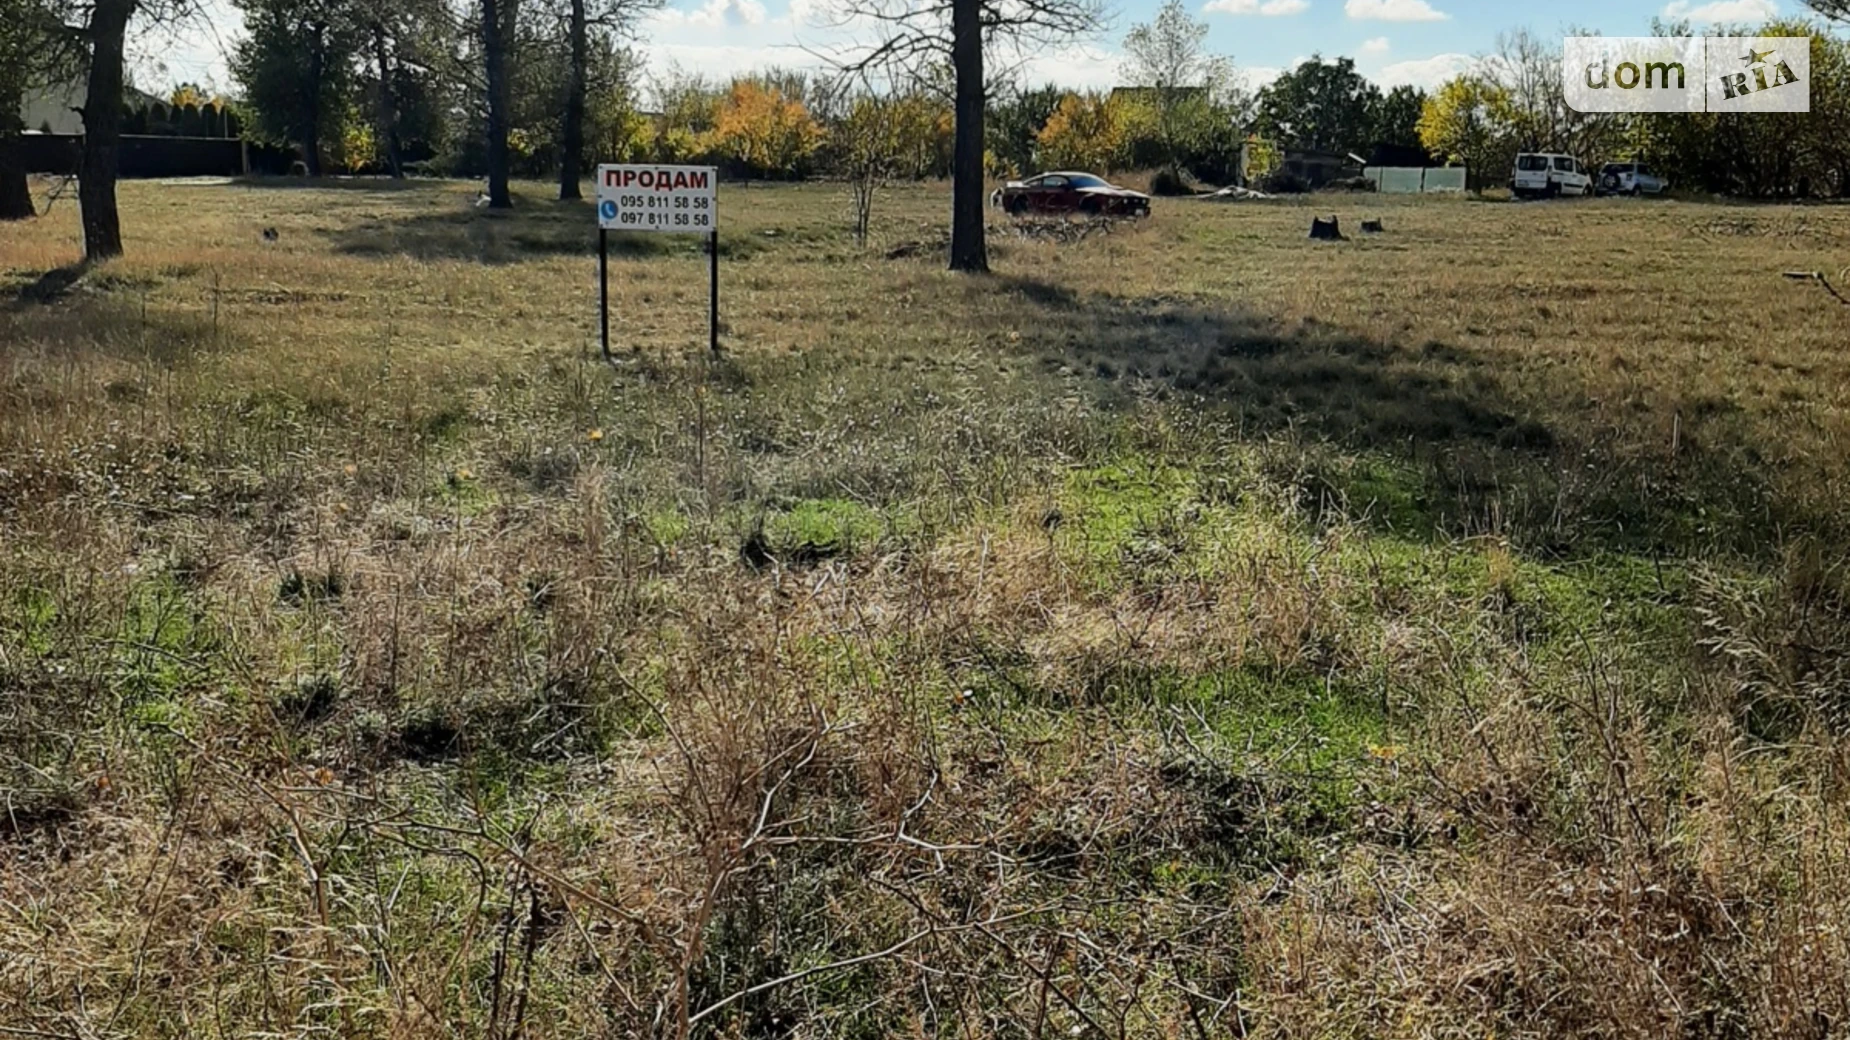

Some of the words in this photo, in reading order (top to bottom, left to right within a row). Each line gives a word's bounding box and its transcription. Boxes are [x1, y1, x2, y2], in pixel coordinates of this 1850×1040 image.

[605, 170, 708, 191] ПРОДАМ
[620, 195, 644, 208] 095
[647, 195, 669, 208] 811
[674, 196, 689, 209] 58
[693, 196, 709, 209] 58
[620, 212, 644, 224] 097
[648, 212, 669, 225] 811
[674, 213, 689, 226] 58
[693, 213, 709, 226] 58
